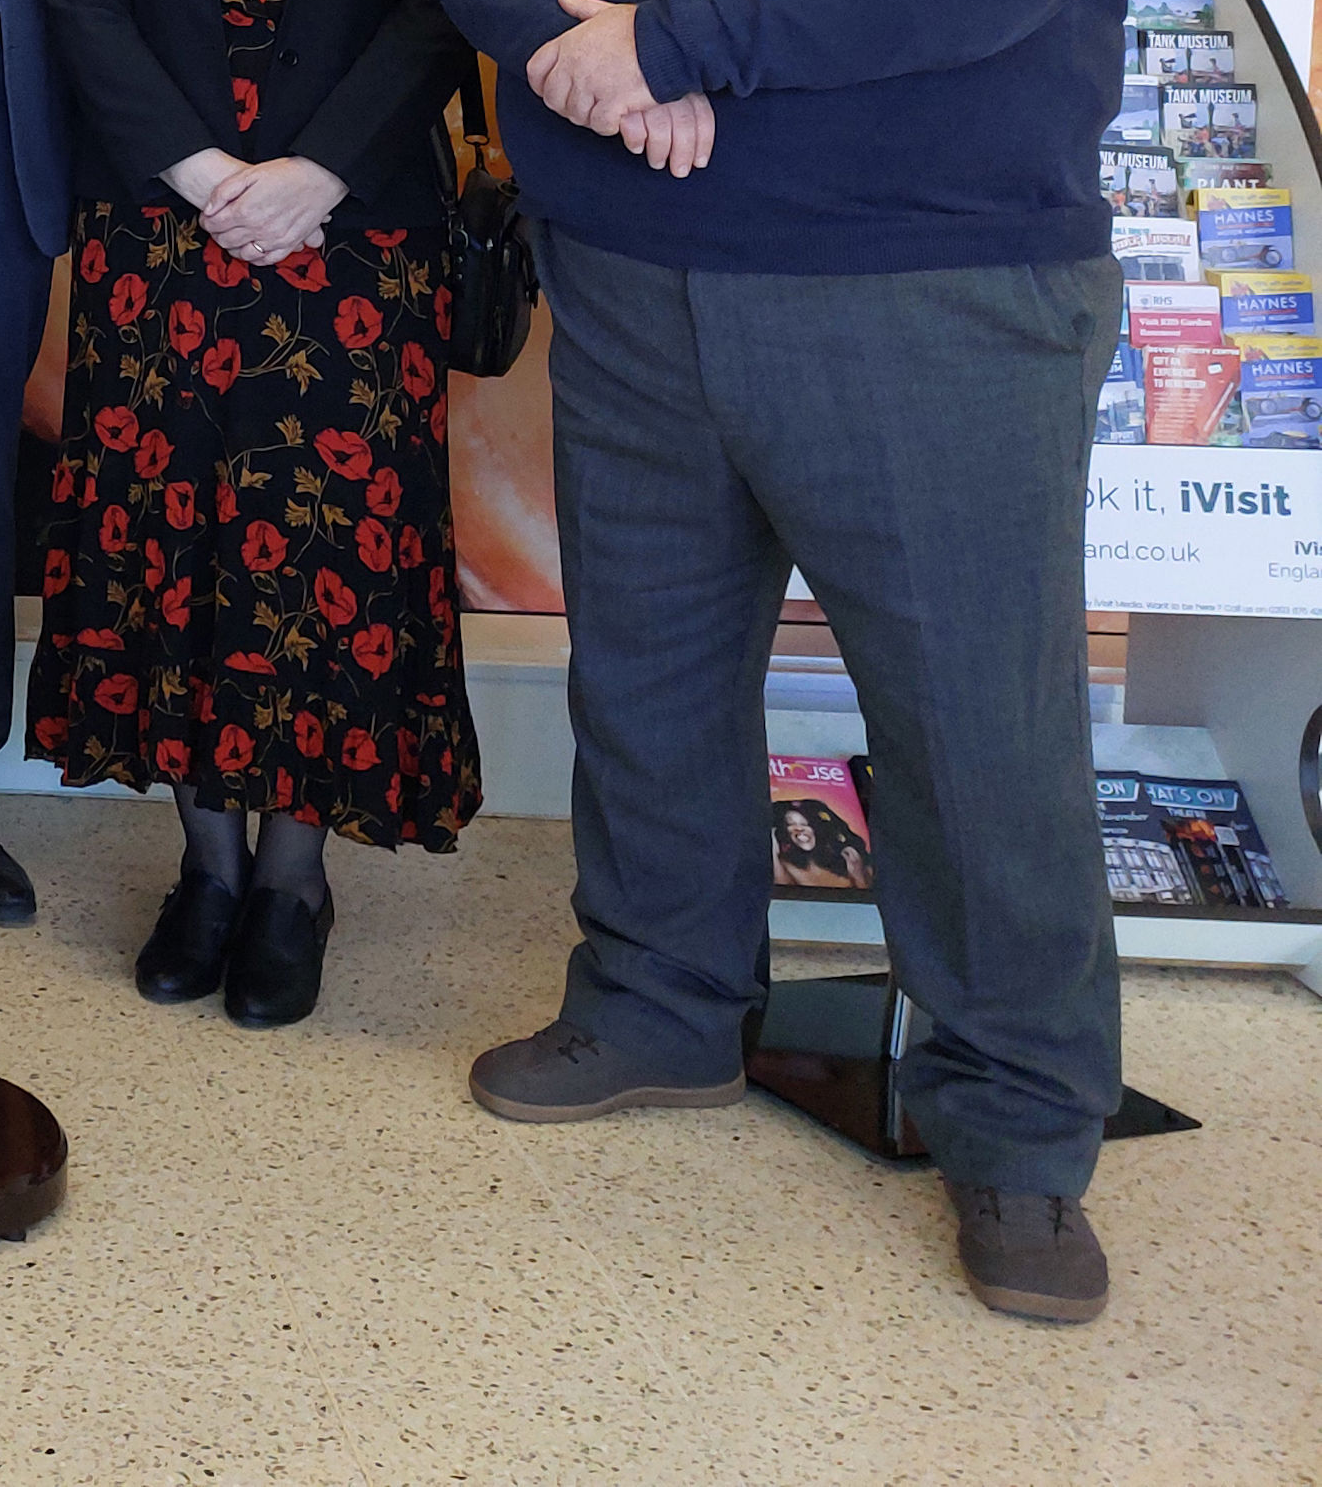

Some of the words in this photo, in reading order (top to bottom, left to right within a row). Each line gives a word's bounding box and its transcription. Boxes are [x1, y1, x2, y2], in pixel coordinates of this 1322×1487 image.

[1148, 34, 1176, 48] TANK
[1166, 89, 1197, 103] TANK
[1215, 209, 1275, 225] HAYNES
[1153, 296, 1173, 306] RHS
[1237, 296, 1297, 310] HAYNES
[1252, 361, 1314, 376] HAYNES
[1134, 478, 1165, 514] it,
[1180, 479, 1291, 516] iVisit
[1097, 780, 1126, 795] ON
[1197, 788, 1225, 804] ON
